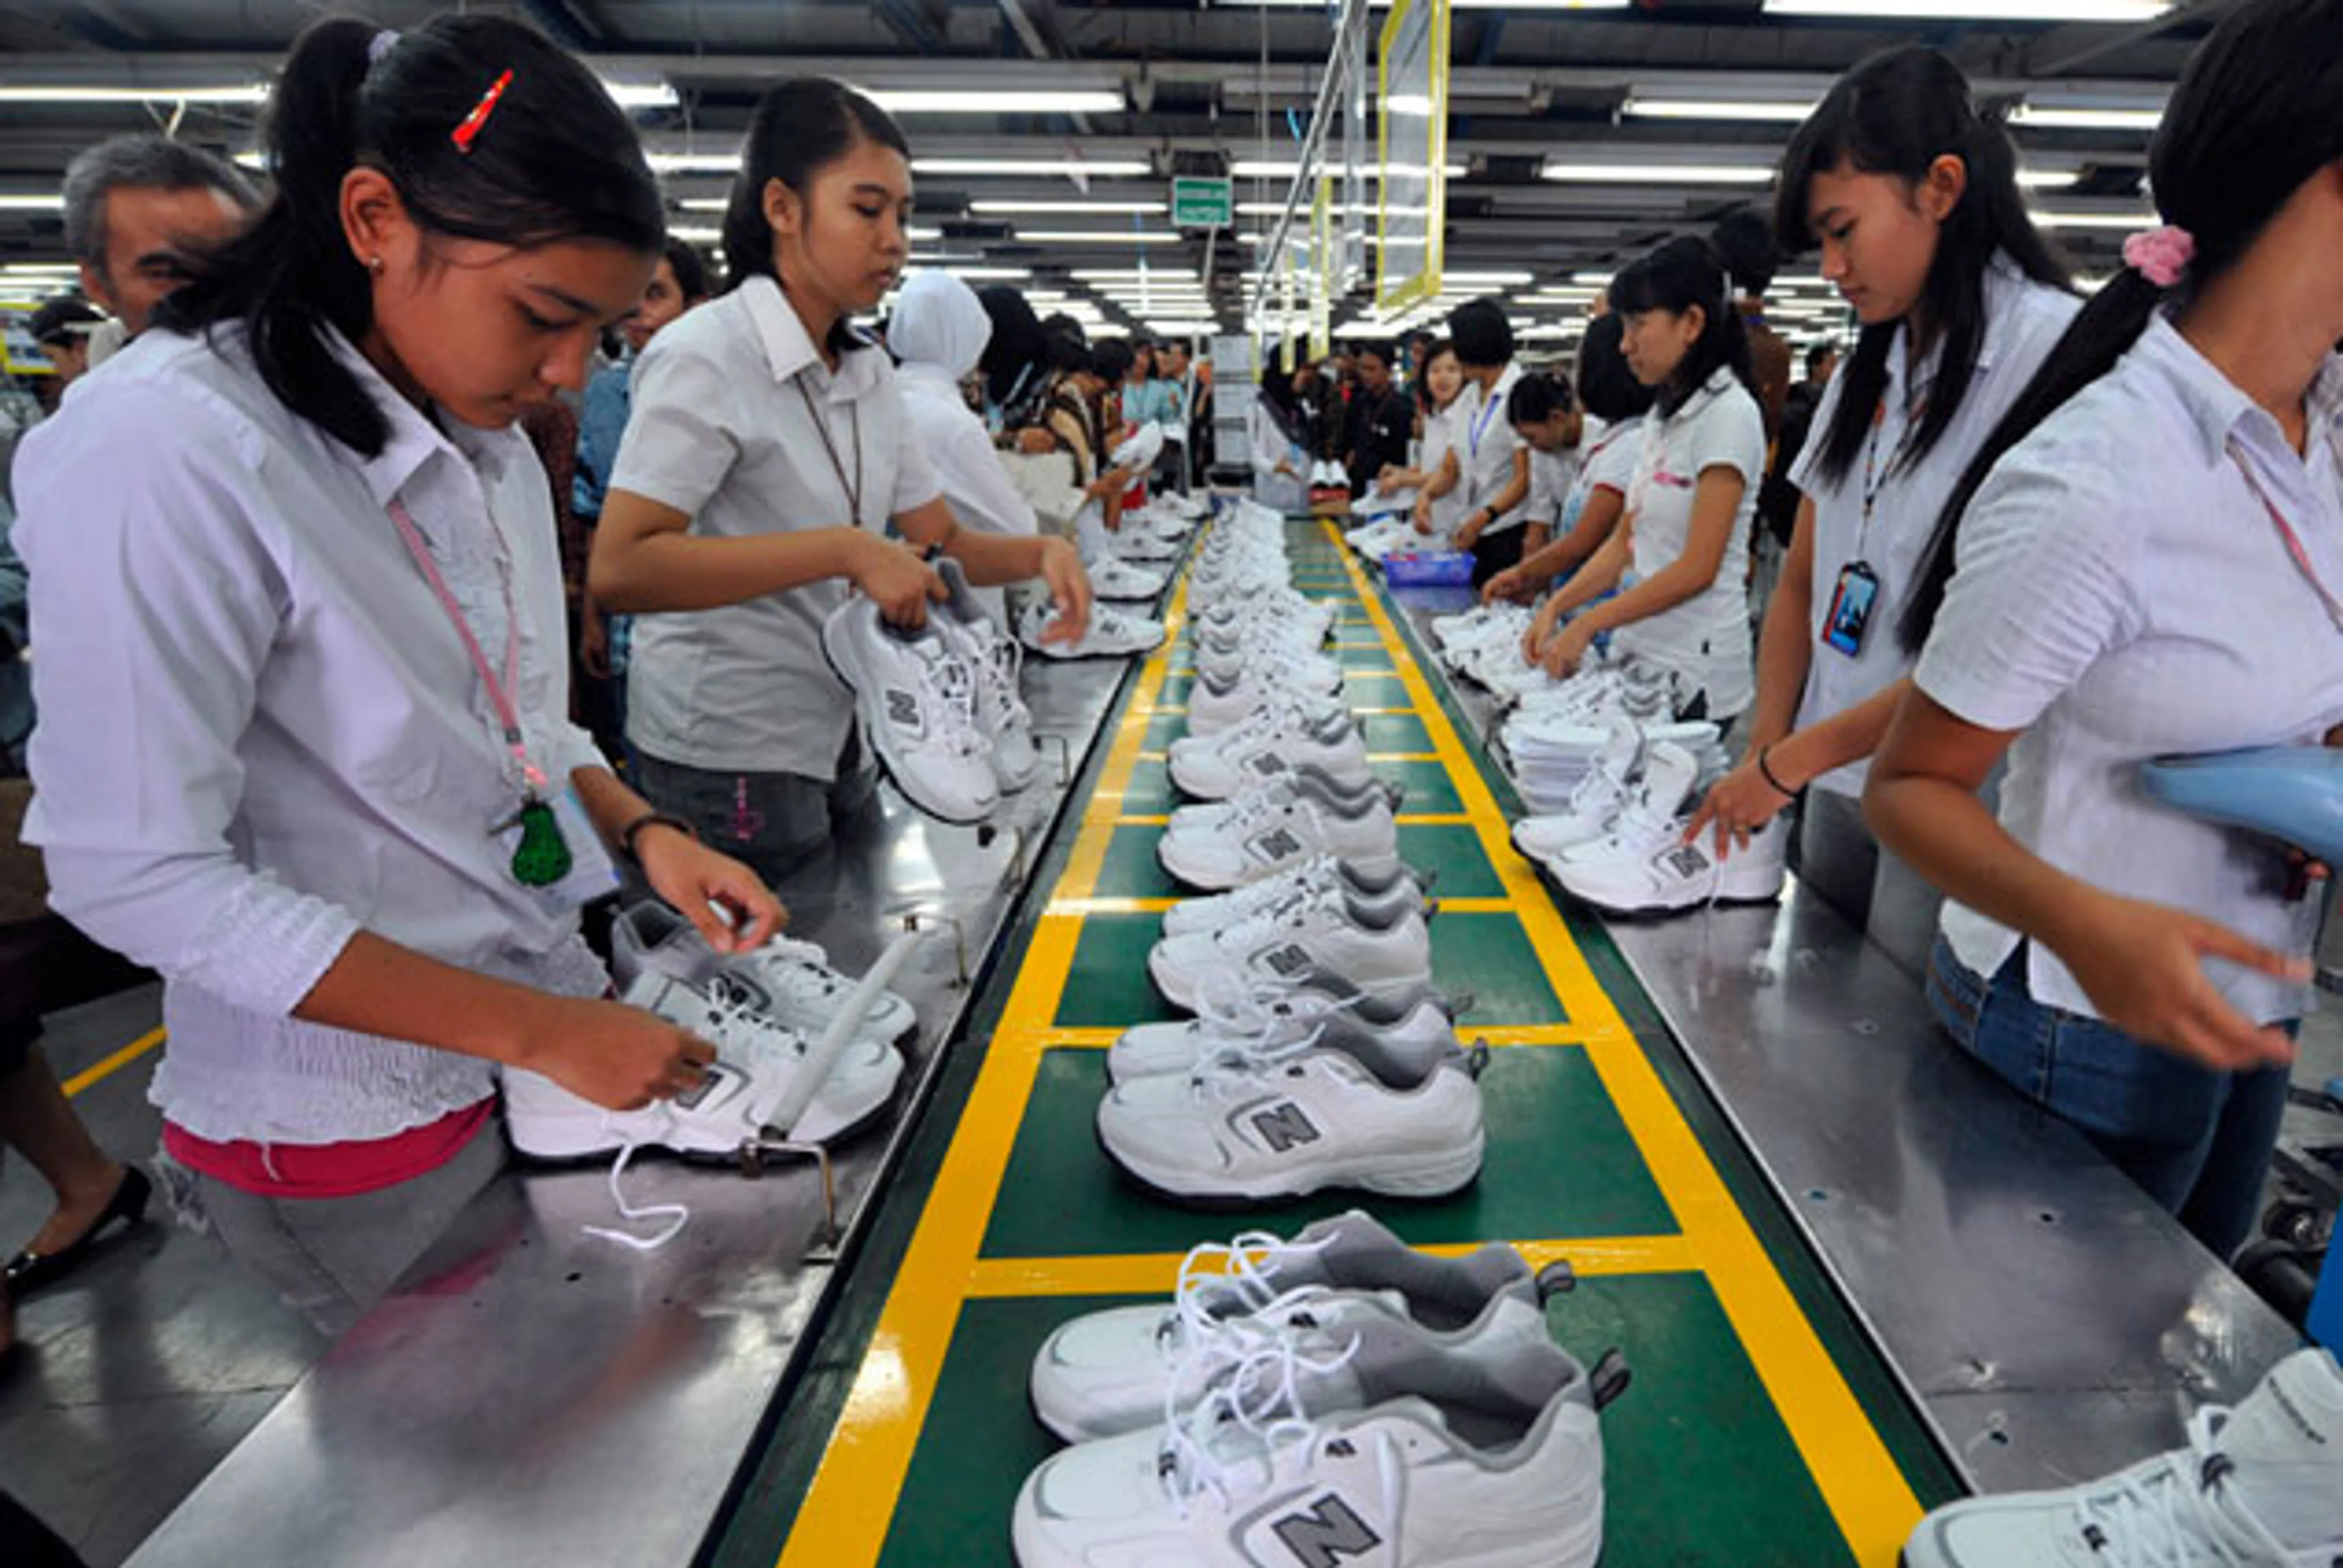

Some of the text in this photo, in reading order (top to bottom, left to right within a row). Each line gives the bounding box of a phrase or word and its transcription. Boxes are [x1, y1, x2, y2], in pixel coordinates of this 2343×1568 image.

[886, 689, 920, 727] N
[1258, 828, 1300, 860] N
[1668, 846, 1710, 879] N
[1251, 1101, 1322, 1152] N
[1271, 1491, 1383, 1568] N
